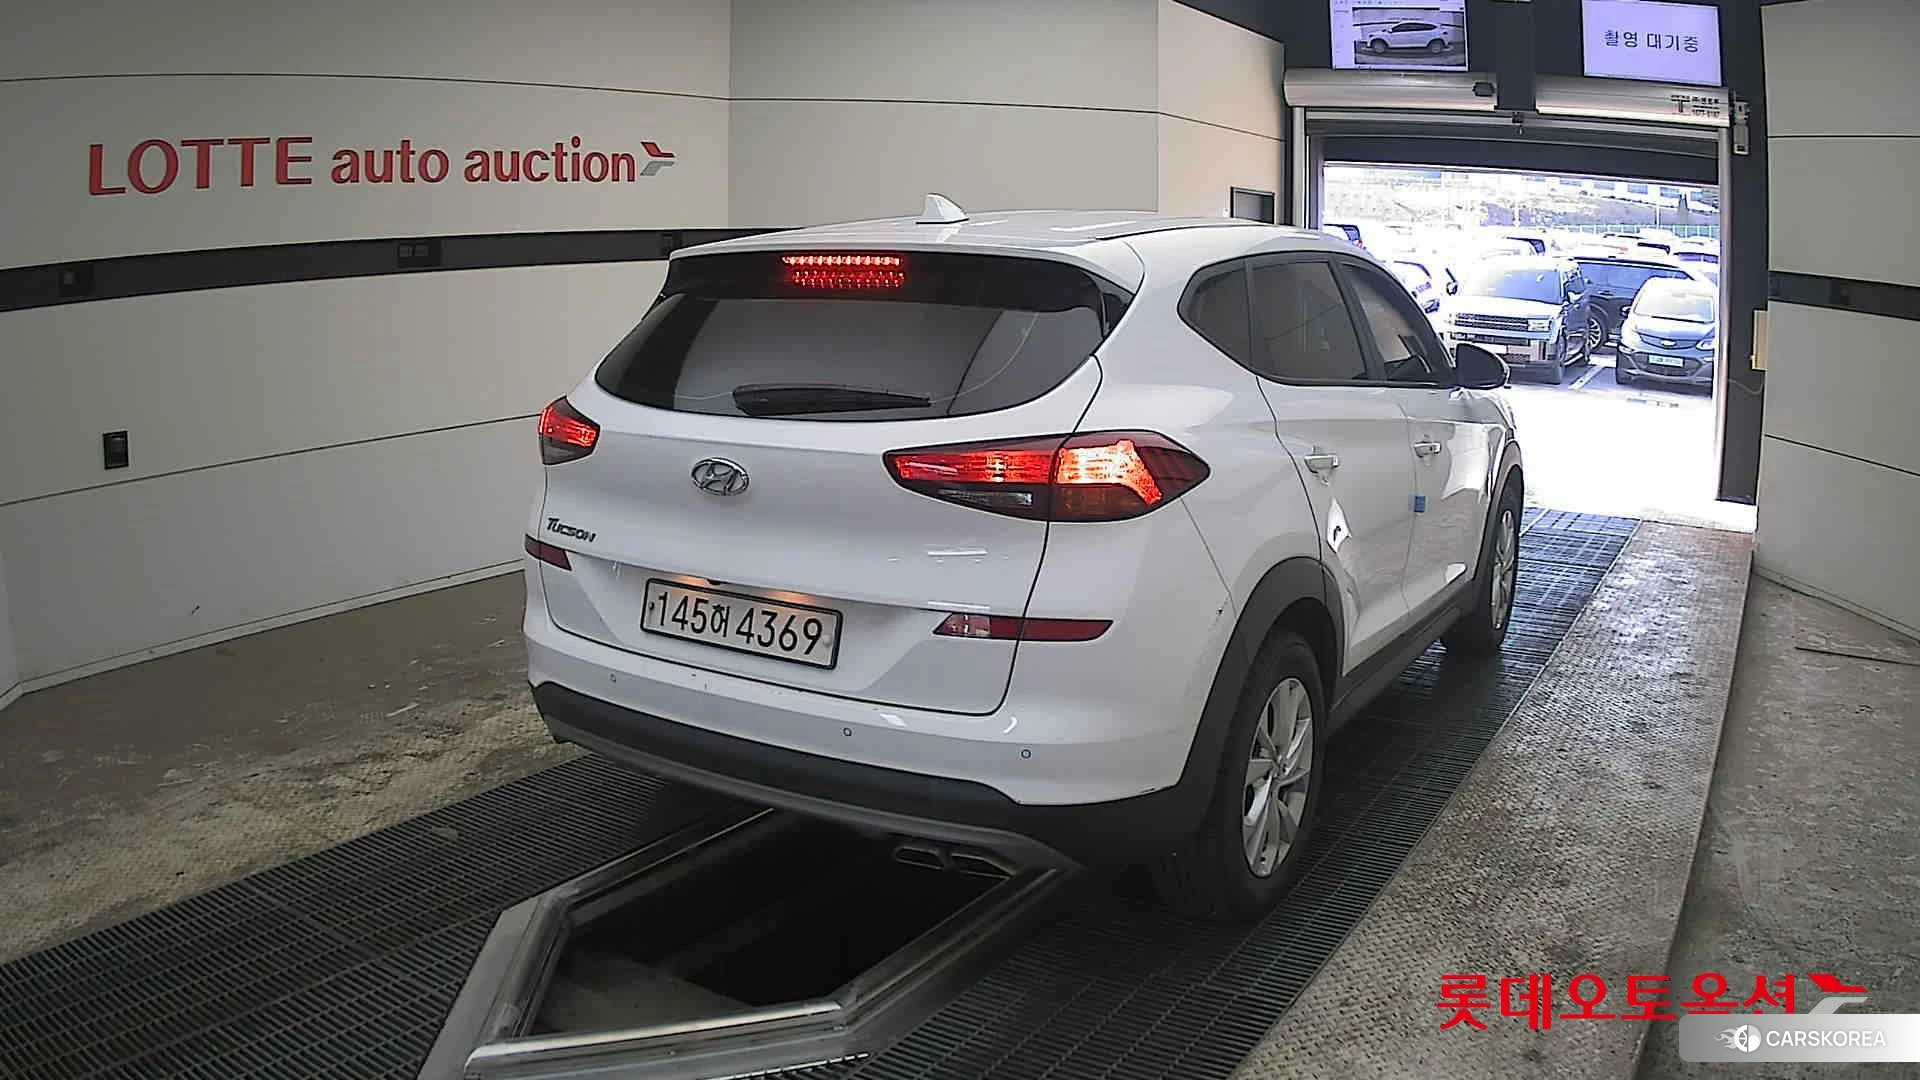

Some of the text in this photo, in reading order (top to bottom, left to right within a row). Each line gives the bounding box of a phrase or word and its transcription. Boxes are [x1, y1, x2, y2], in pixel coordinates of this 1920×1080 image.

[1646, 33, 1698, 53] 대기중
[89, 136, 636, 196] LOTTE auto auction
[657, 591, 823, 655] 145허 4369
